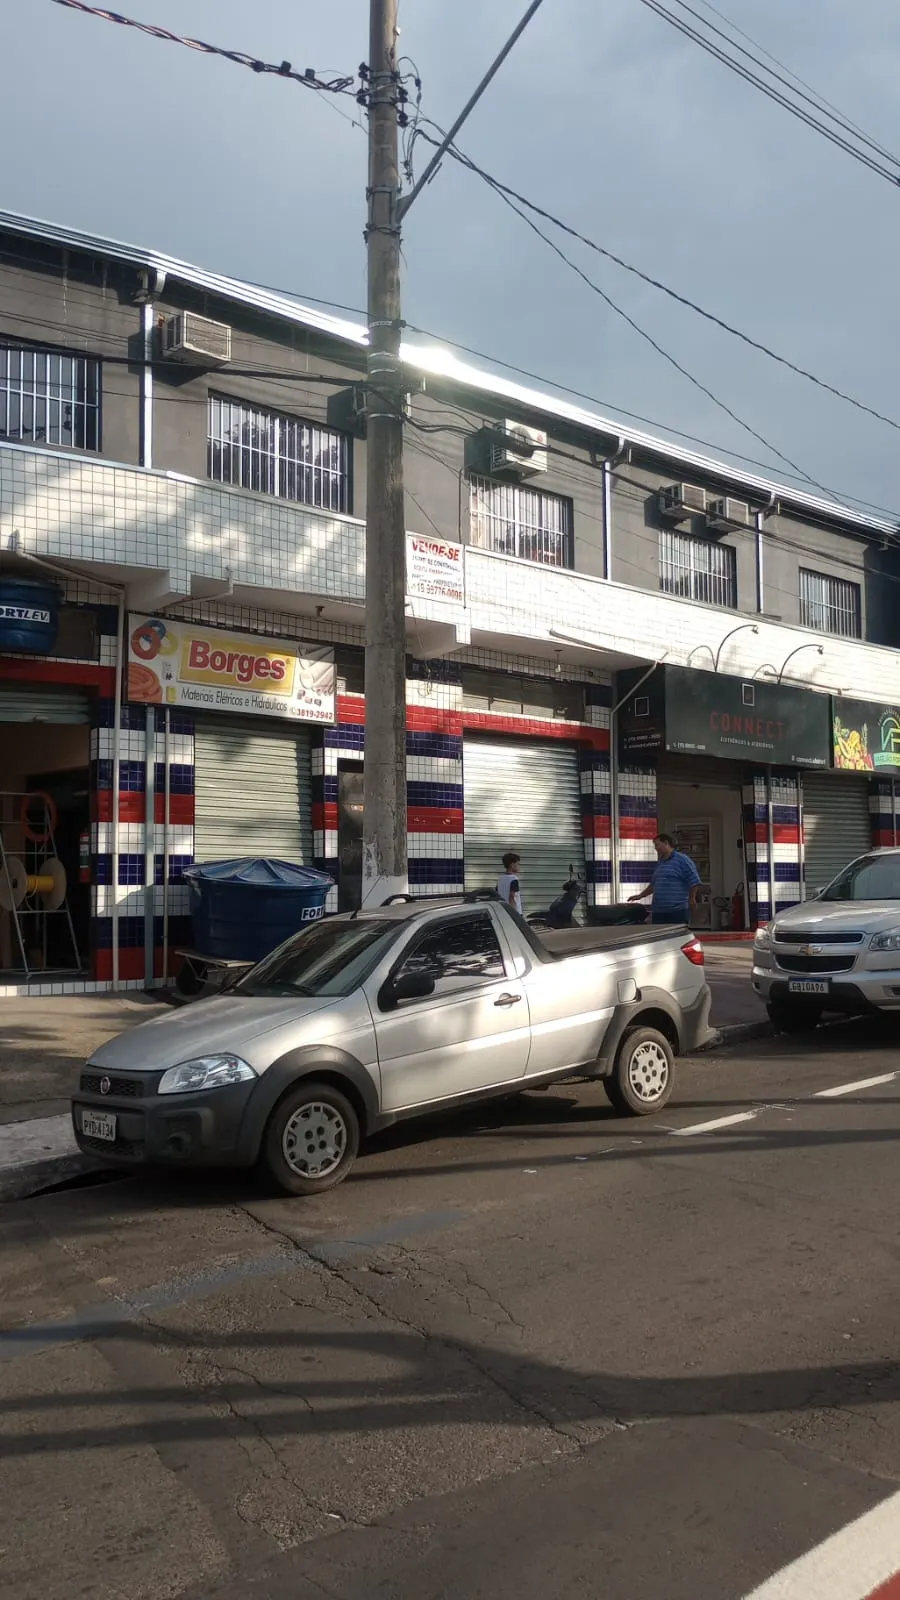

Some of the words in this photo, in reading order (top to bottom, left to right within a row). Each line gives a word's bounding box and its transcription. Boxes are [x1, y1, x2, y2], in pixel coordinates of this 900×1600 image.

[411, 539, 460, 561] VENDE-SE
[188, 640, 286, 682] Borges
[181, 687, 213, 704] Materiais
[216, 691, 243, 707] Elétricos
[251, 694, 288, 712] Hidráulicos
[709, 711, 784, 740] CONNECT
